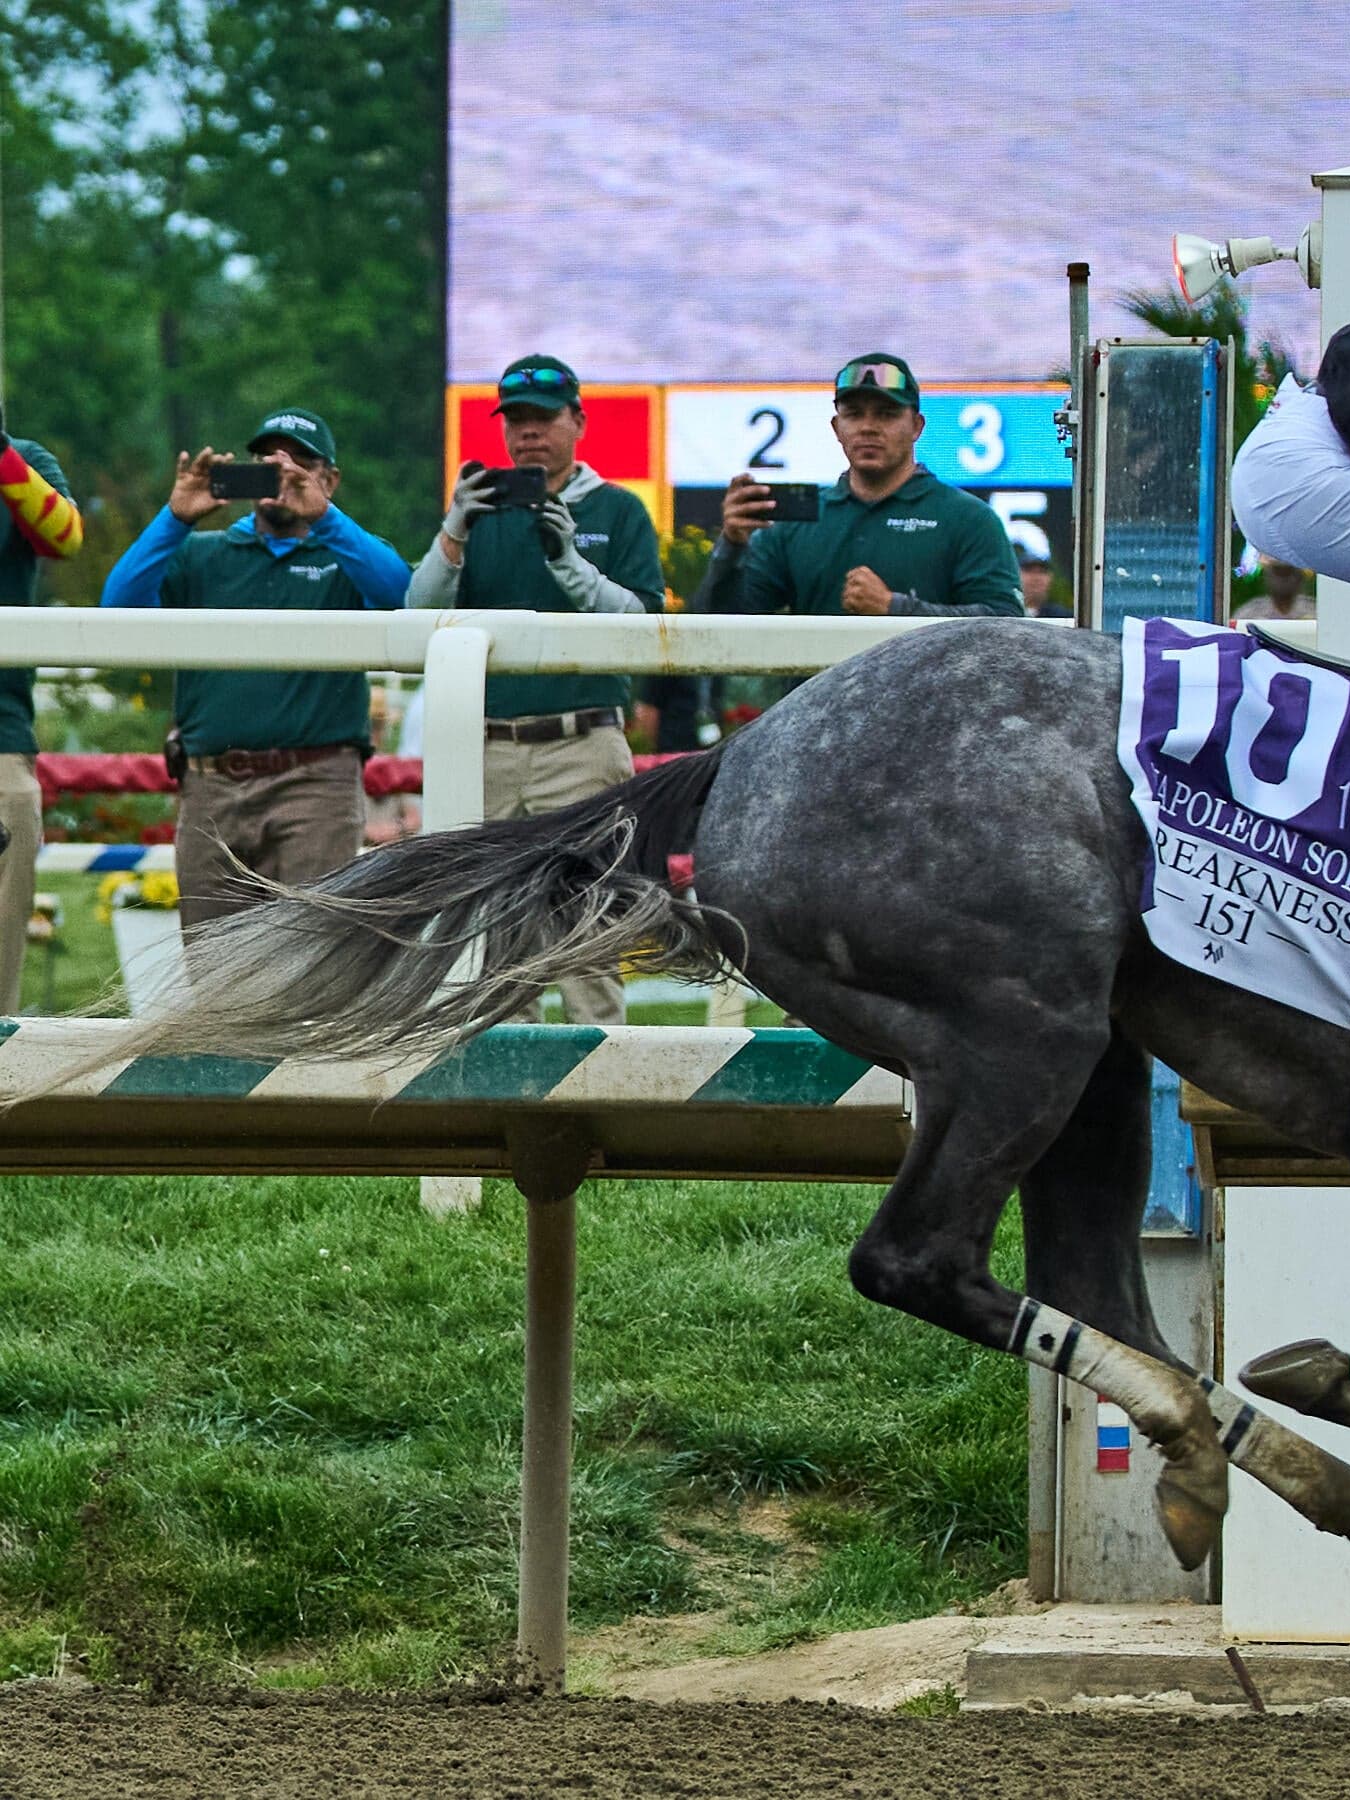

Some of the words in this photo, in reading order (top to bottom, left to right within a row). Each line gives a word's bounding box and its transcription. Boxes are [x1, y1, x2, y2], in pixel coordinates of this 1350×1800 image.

[747, 409, 786, 469] 2
[957, 401, 1006, 474] 3
[1160, 642, 1350, 821] 10
[1151, 762, 1301, 864] APOLEON
[1194, 893, 1257, 946] 151
